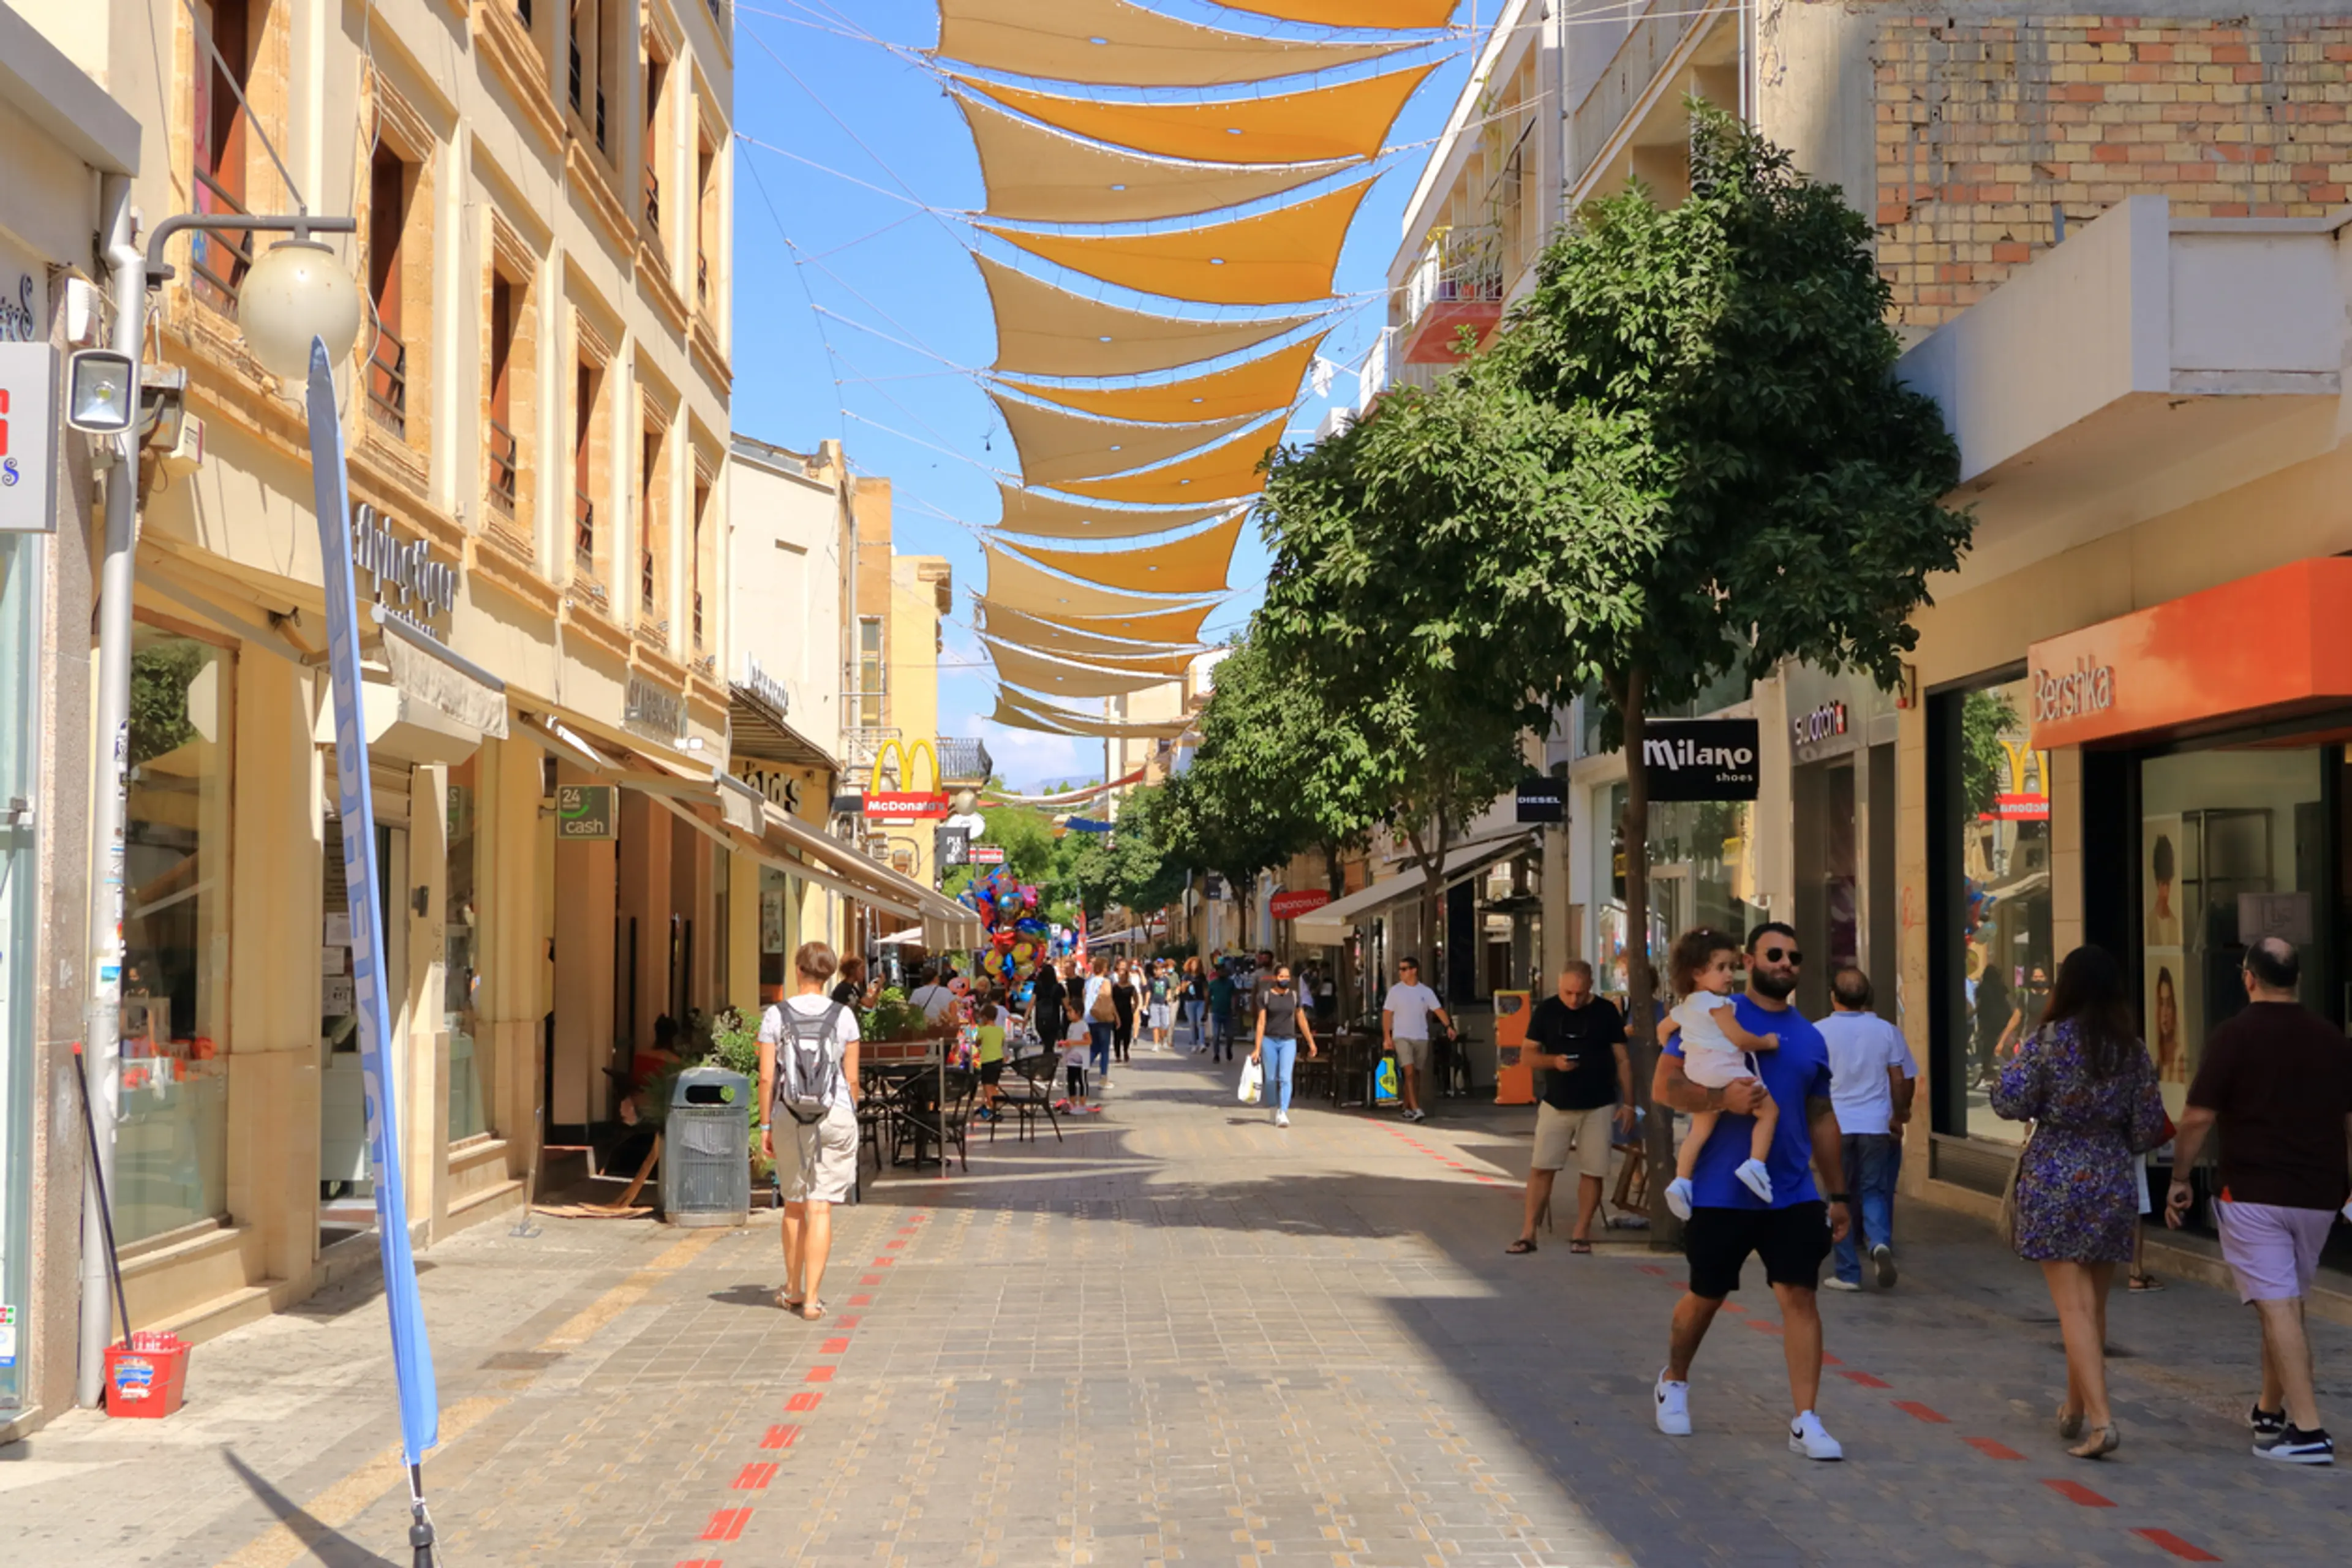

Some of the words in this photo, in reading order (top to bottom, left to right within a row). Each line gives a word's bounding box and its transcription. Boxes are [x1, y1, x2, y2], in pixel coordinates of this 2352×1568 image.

[2035, 655, 2111, 722] Bershka
[1643, 739, 1753, 771] Milano
[1716, 772, 1753, 782] shoes
[562, 788, 581, 803] 24
[735, 771, 803, 813] ald's
[867, 801, 945, 812] McDonald's
[565, 818, 605, 834] cash
